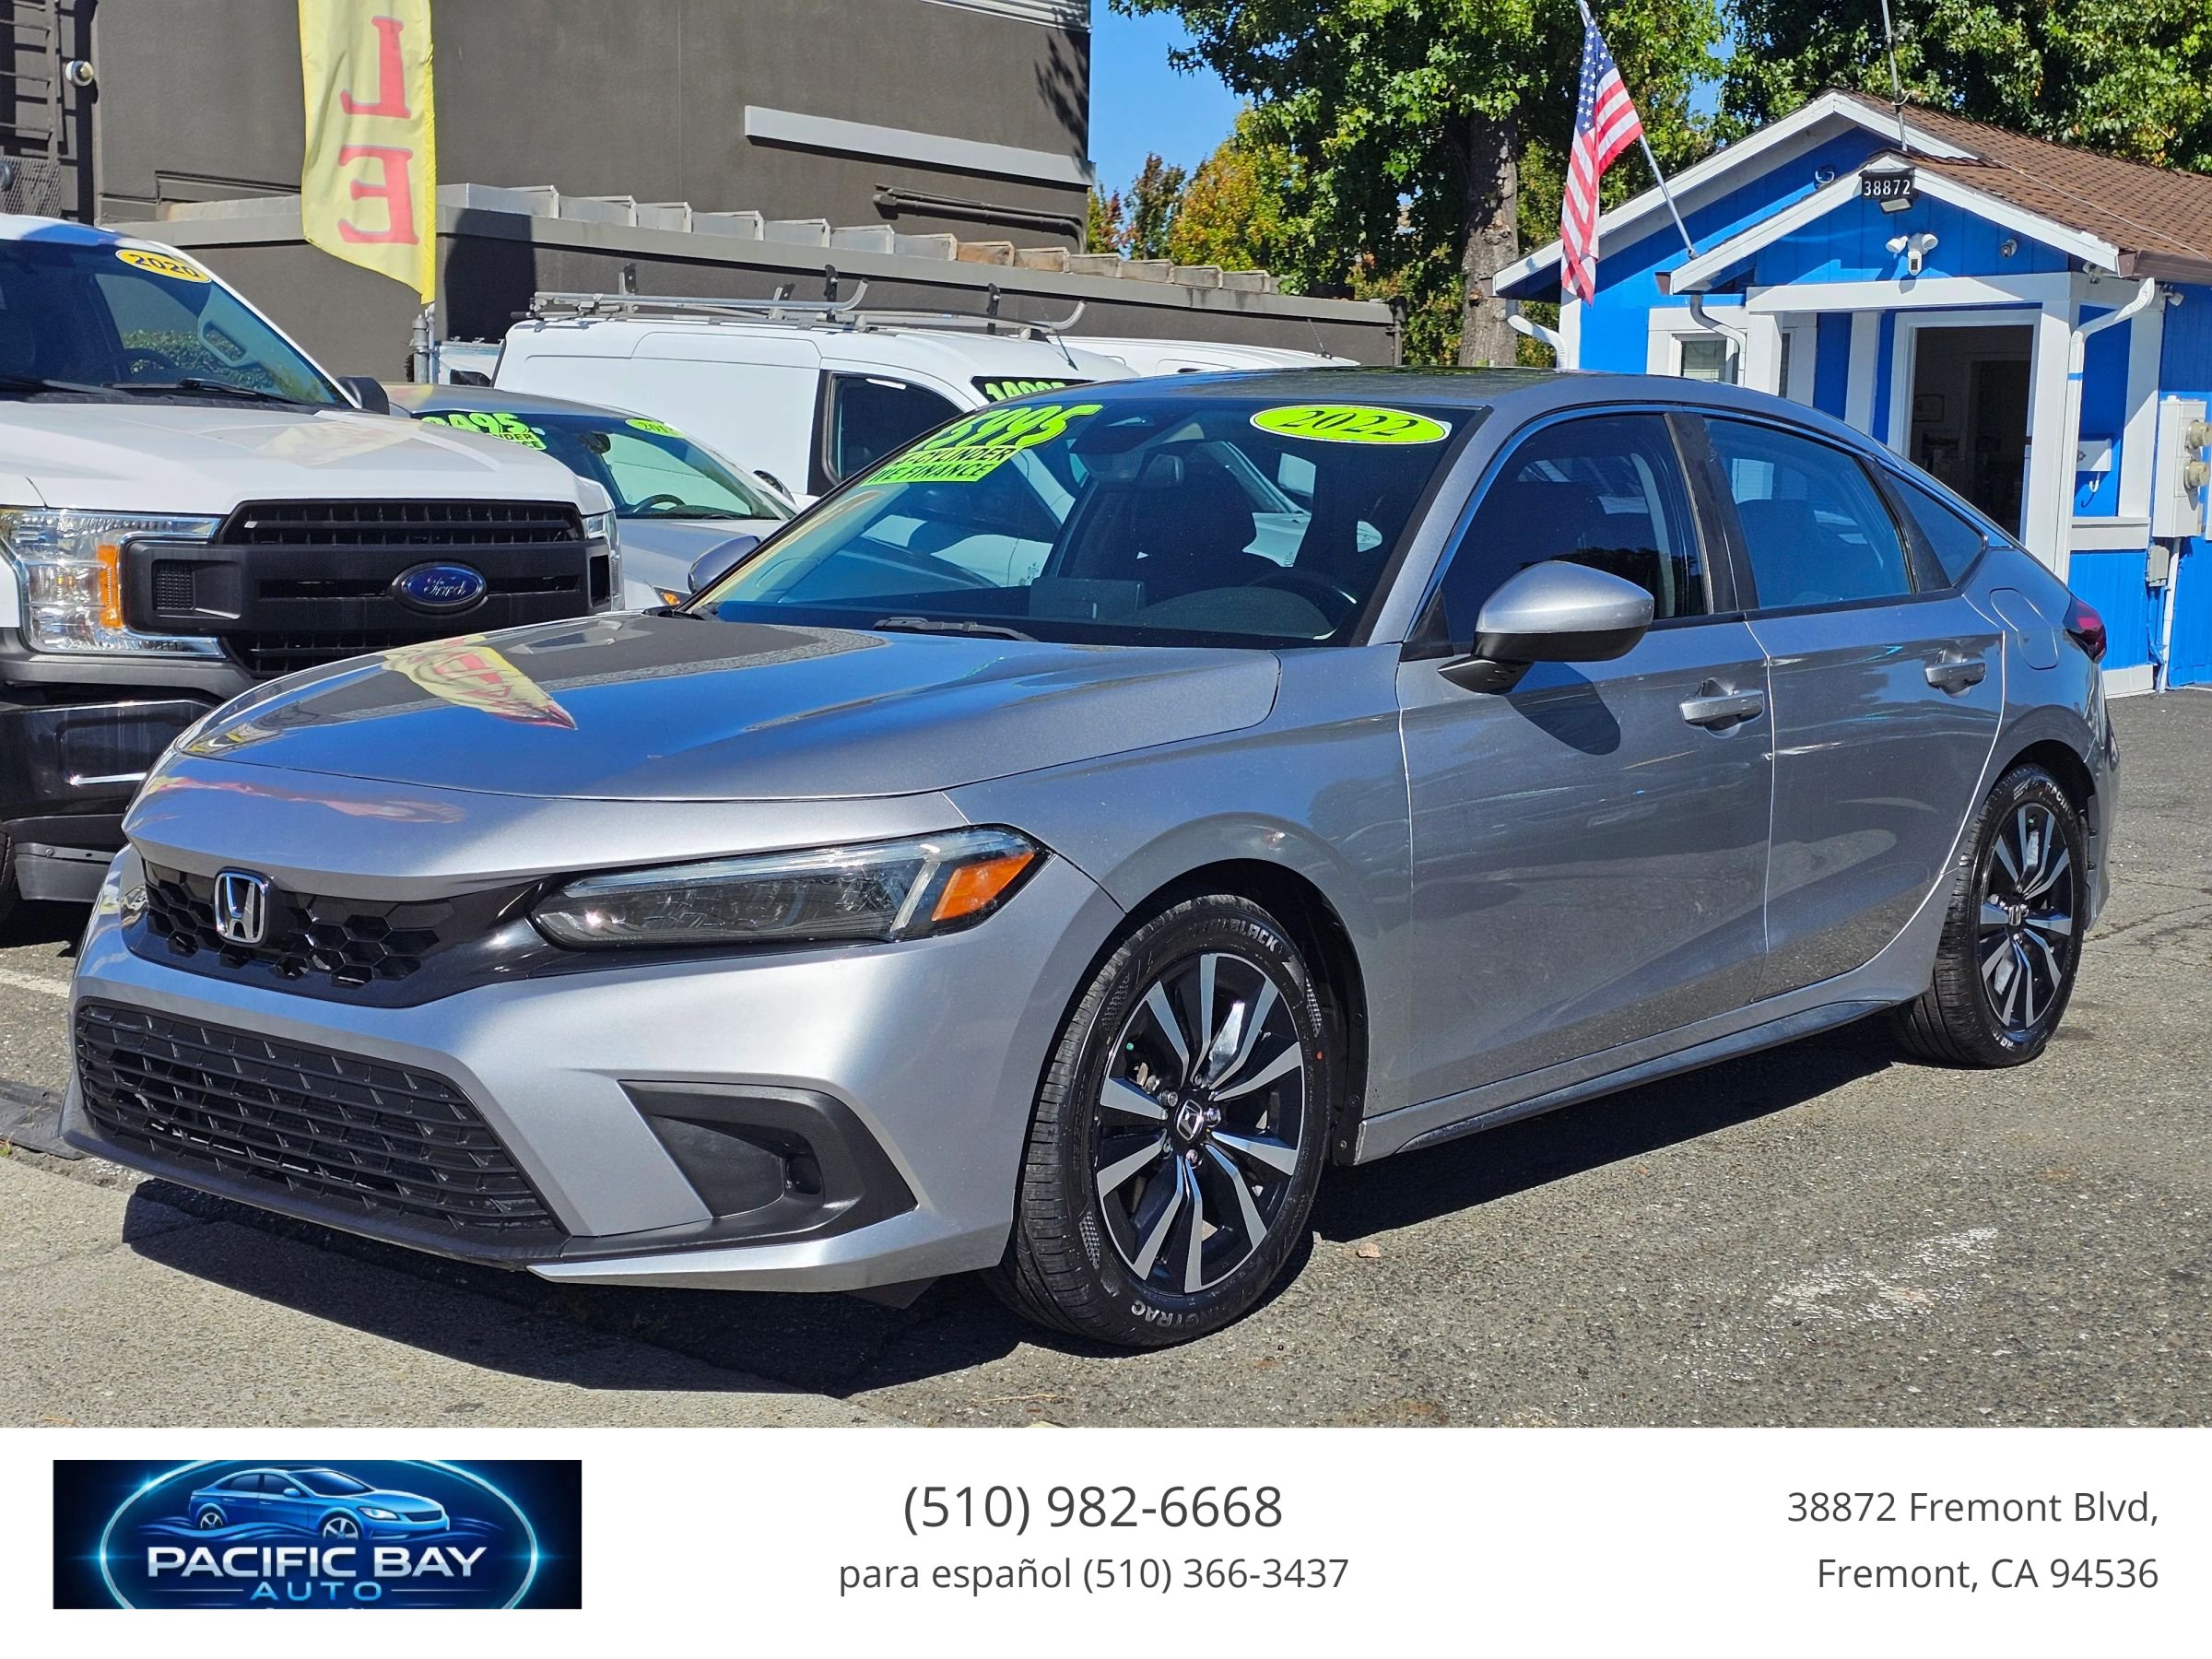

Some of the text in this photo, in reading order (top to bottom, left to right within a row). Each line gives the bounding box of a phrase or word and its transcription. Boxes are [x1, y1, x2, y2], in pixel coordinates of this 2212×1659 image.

[1864, 179, 1911, 196] 38872
[129, 253, 199, 278] 2020
[1277, 410, 1419, 437] 2022
[898, 463, 994, 479] FINANCE
[423, 576, 466, 597] Ford
